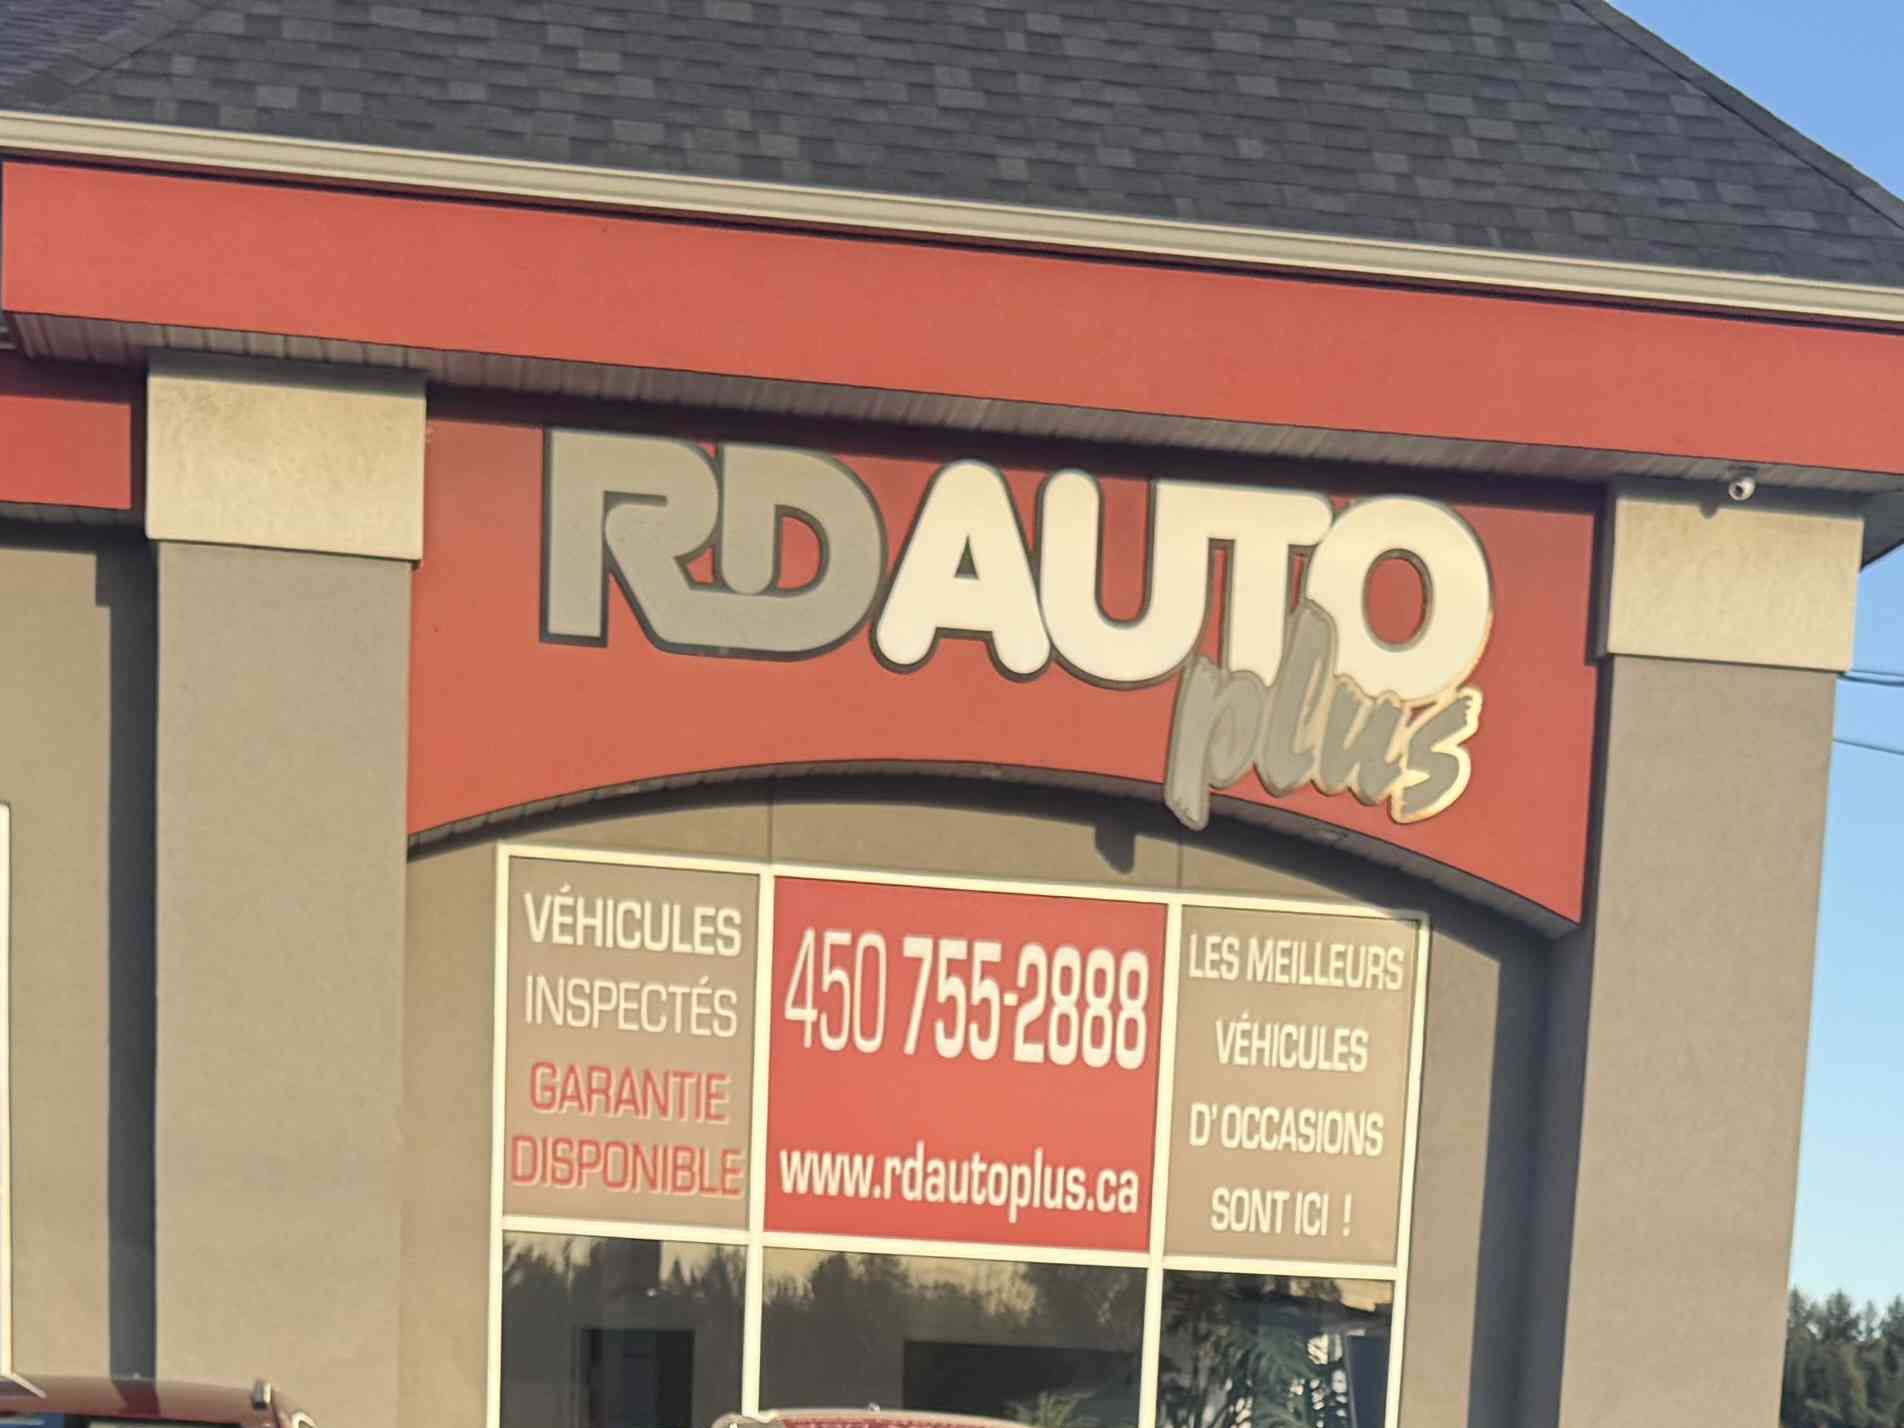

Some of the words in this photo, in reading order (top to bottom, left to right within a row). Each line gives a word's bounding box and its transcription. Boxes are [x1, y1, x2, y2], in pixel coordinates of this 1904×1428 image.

[1164, 596, 1483, 830] plus
[524, 881, 742, 957] VÉHICULES
[1189, 933, 1240, 981] LES
[1247, 937, 1405, 990] MEILLEURS
[524, 975, 738, 1037] INSPECTÉS
[784, 927, 887, 1054] 450
[902, 935, 1149, 1070] 755-2888
[1215, 1009, 1369, 1072] VÉHICULES
[529, 1060, 732, 1126] GARANTIE
[511, 1134, 746, 1200] DISPONIBLE
[779, 1140, 1139, 1224] www.rdautoplus.ca
[1211, 1186, 1290, 1234] SONT
[1295, 1191, 1328, 1237] ICI
